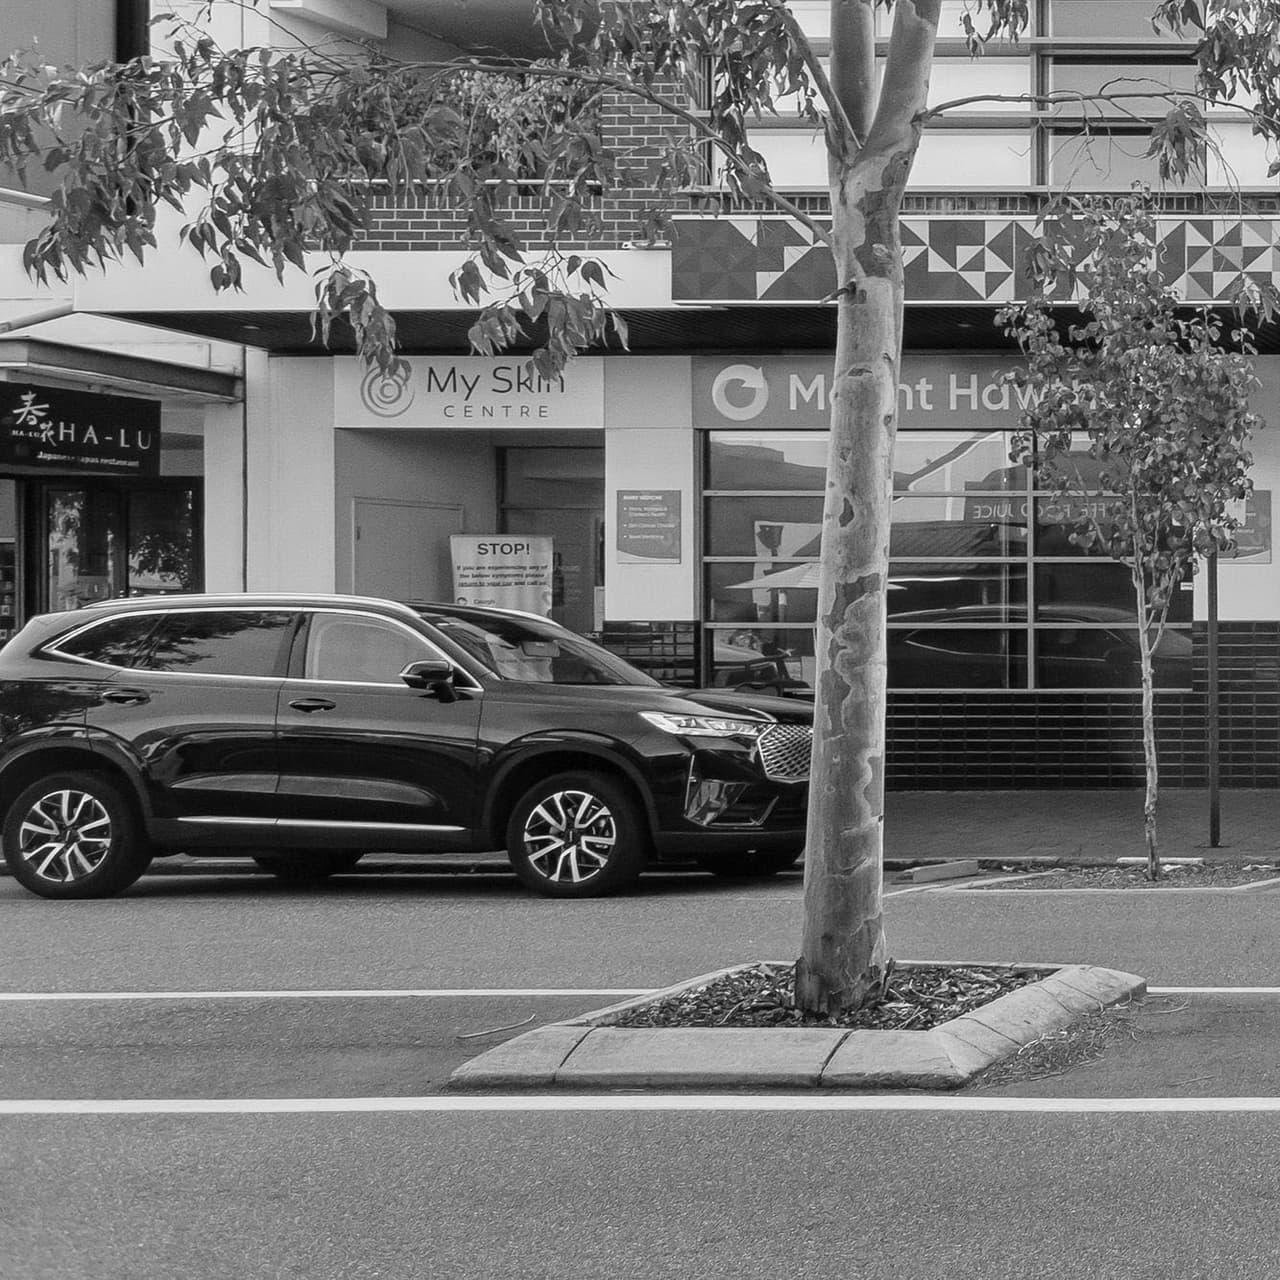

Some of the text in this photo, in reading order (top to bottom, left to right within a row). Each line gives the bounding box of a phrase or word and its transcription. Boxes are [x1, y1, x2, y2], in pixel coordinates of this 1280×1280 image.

[427, 366, 480, 401] My
[789, 374, 933, 411] Mnt
[443, 405, 549, 418] CENTRE
[59, 421, 151, 450] HA-LU
[477, 543, 530, 555] STOP!
